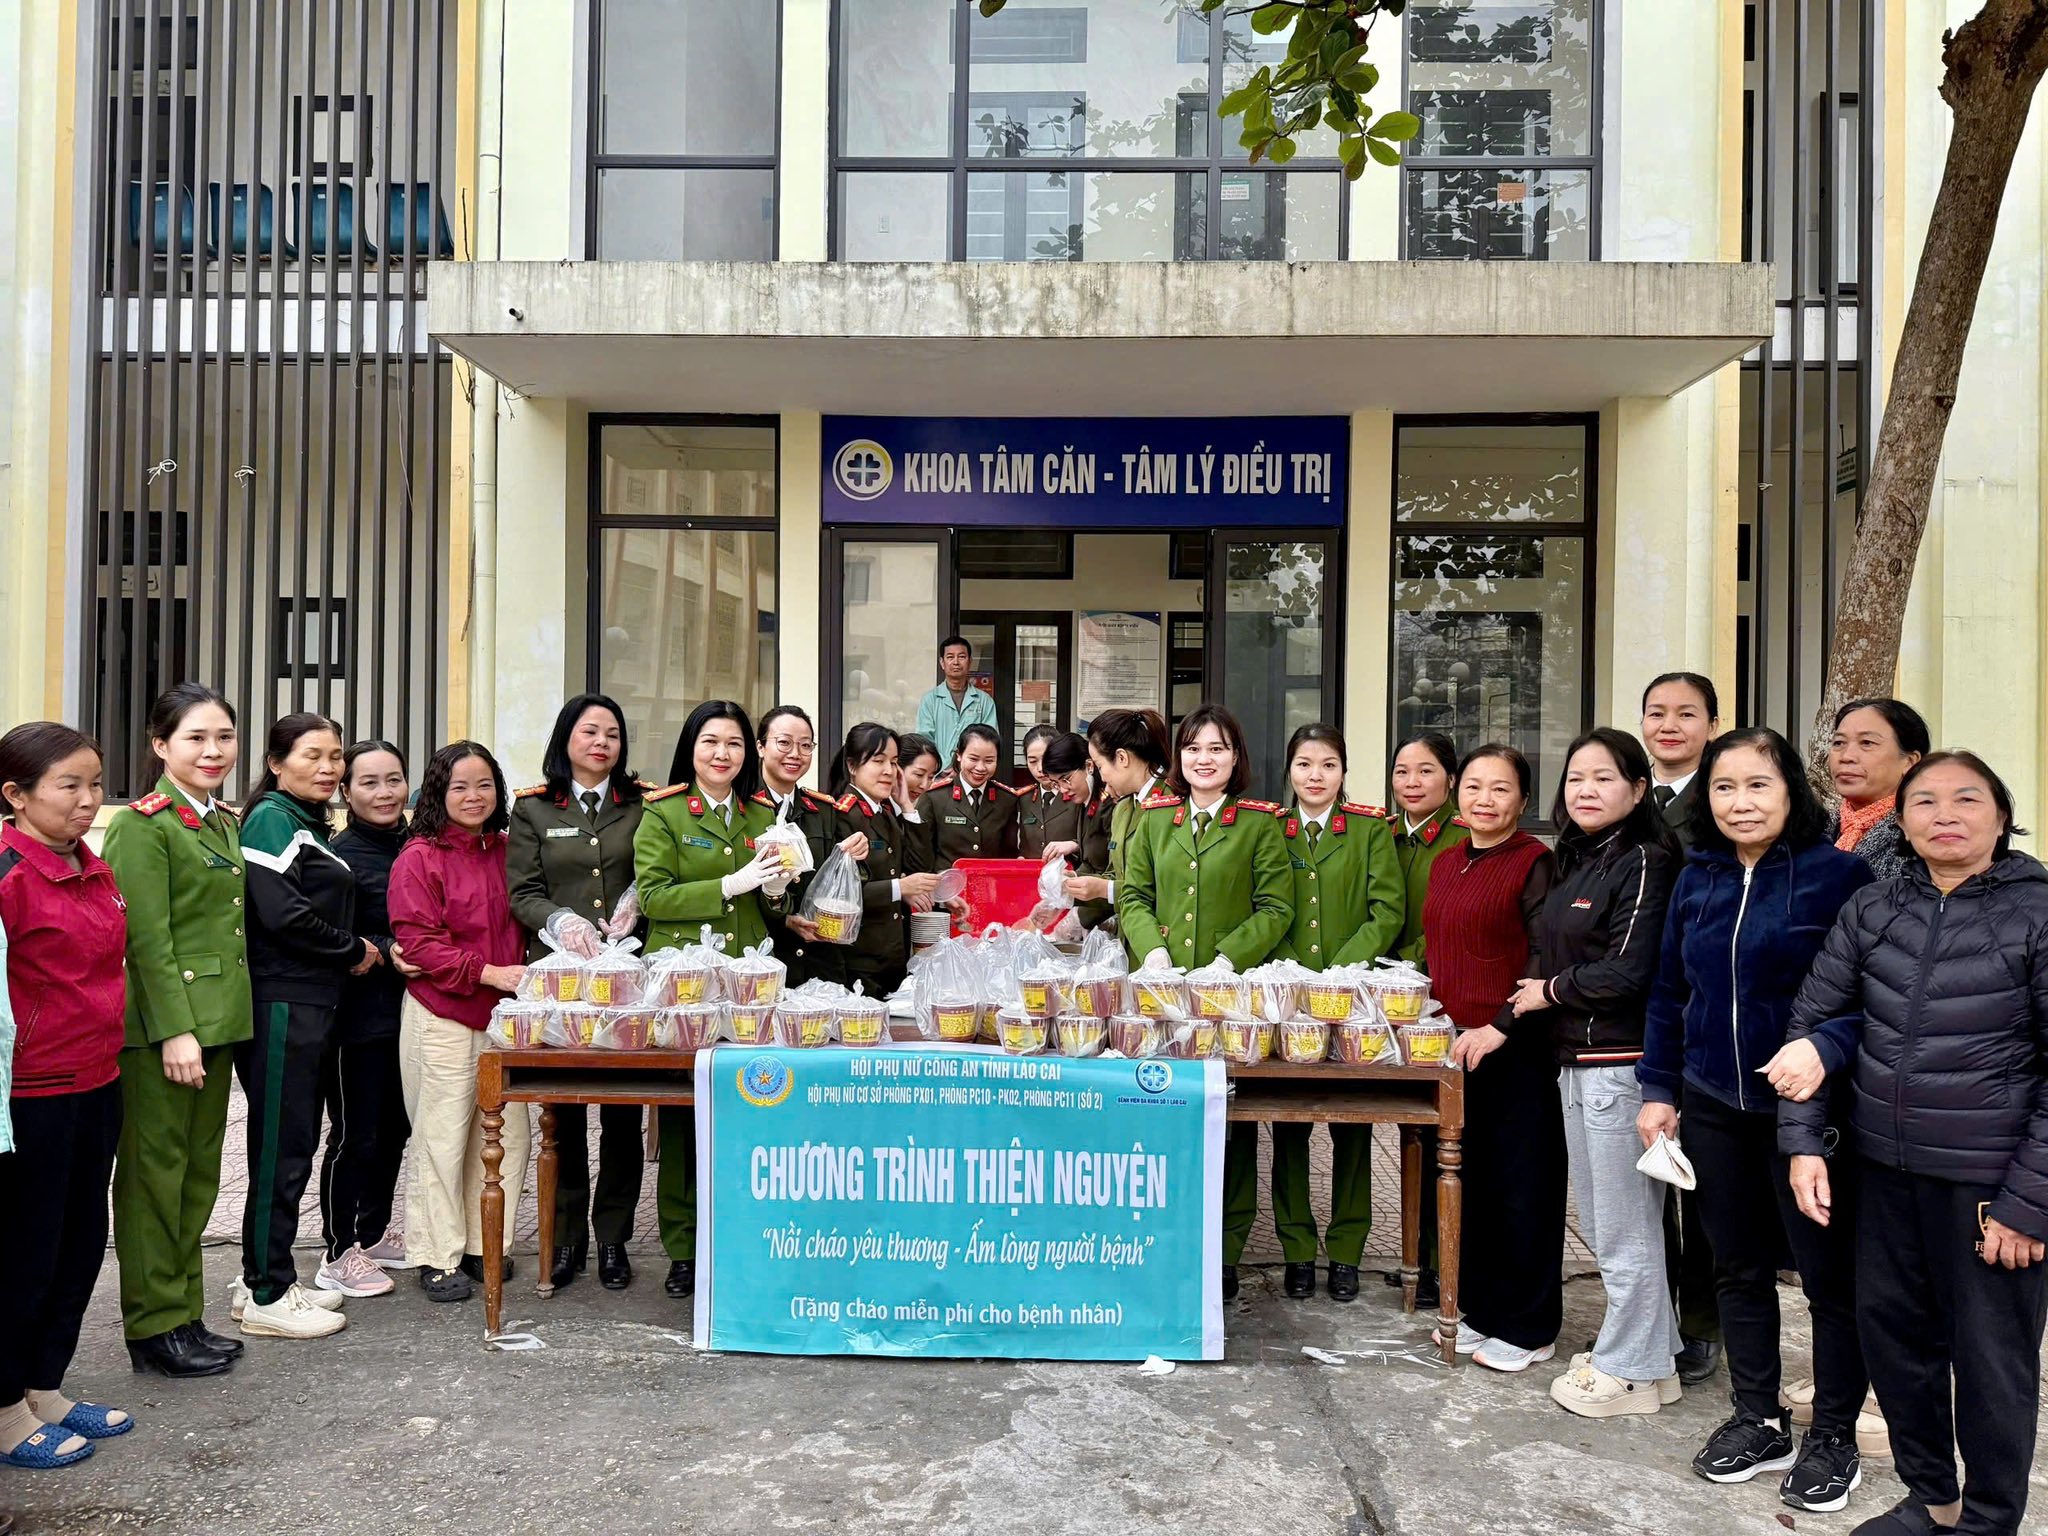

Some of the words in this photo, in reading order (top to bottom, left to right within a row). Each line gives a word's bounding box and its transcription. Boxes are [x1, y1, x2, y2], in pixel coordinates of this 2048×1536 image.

[904, 452, 972, 493] KHOA
[979, 445, 1034, 493] TÂM
[1043, 445, 1096, 494] CĂN
[1104, 472, 1114, 481] -
[1121, 445, 1177, 494] TÂM
[1185, 445, 1216, 494] LÝ
[1222, 440, 1283, 495] ĐIỀU
[1290, 453, 1331, 503] TRỊ
[850, 1056, 871, 1080] HỘI
[875, 1059, 900, 1080] PHỤ
[903, 1056, 923, 1077] NỮ
[924, 1057, 958, 1077] CÔNG
[961, 1060, 979, 1077] AN
[1013, 1060, 1036, 1079] LÀO
[1040, 1062, 1061, 1080] CAI
[807, 1083, 822, 1106] HỘI
[824, 1086, 841, 1106] PHỤ
[843, 1082, 856, 1103] NỮ
[857, 1085, 869, 1103] CƠ
[870, 1080, 883, 1103] SỞ
[884, 1083, 912, 1104] PHÒNG
[914, 1086, 937, 1106] PX01,
[940, 1083, 968, 1105] PHÒNG
[969, 1088, 991, 1105] PC10
[998, 1089, 1022, 1107] PK02,
[1024, 1086, 1052, 1108] PHÒNG
[1054, 1091, 1075, 1108] PC11
[1078, 1086, 1093, 1110] (SỐ
[1094, 1093, 1103, 1110] 2)
[751, 1141, 865, 1201] CHƯƠNG
[873, 1136, 955, 1203] TRÌNH
[964, 1137, 1044, 1217] THIỆN
[1054, 1142, 1167, 1221] NGUYỆN
[805, 1228, 848, 1259] cháo
[849, 1229, 883, 1266] yêu
[887, 1232, 949, 1270] thương
[964, 1218, 996, 1264] Ấm
[1000, 1232, 1041, 1271] lòng
[1044, 1232, 1097, 1271] người
[1100, 1234, 1155, 1271] bệnh”
[790, 1296, 840, 1322] (Tặng
[846, 1297, 888, 1320] cháo
[894, 1298, 938, 1321] miễn
[945, 1303, 974, 1326] phí
[979, 1303, 1012, 1324] cho
[1018, 1304, 1063, 1328] bệnh
[1070, 1302, 1122, 1327] nhân)
